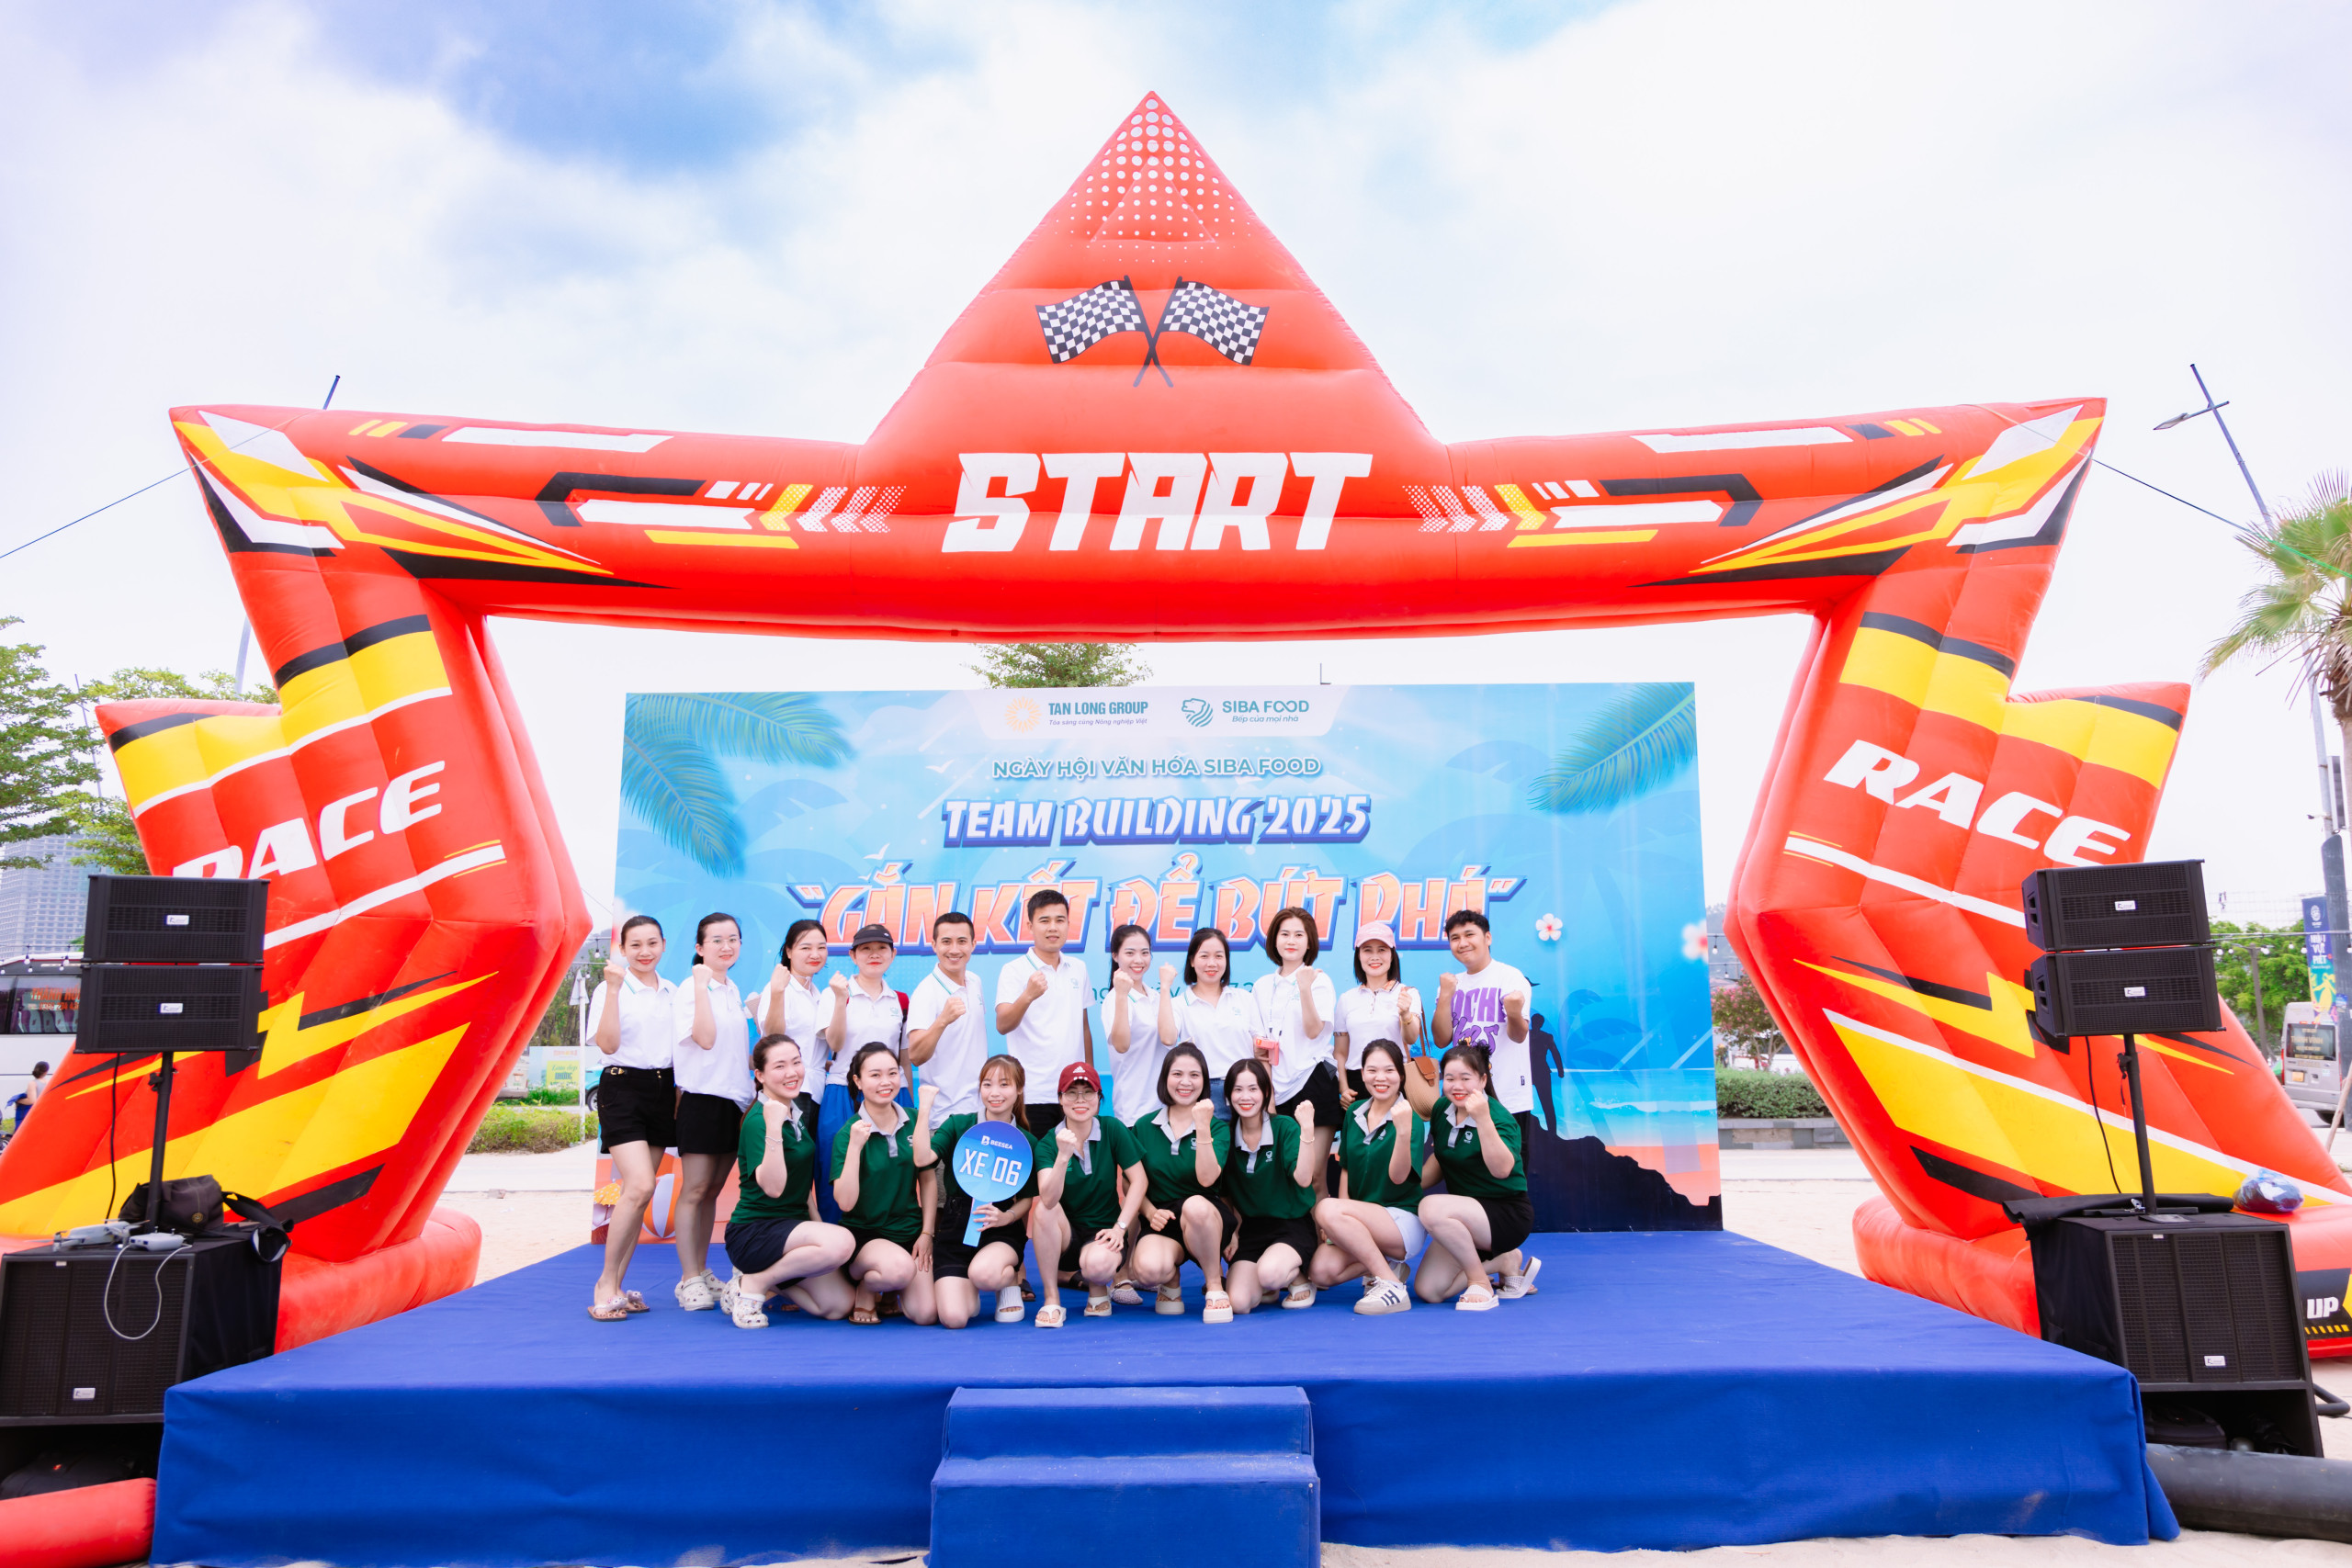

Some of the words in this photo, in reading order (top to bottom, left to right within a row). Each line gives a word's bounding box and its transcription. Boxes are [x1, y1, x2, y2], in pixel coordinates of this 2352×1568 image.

[941, 451, 1374, 553] START
[1048, 702, 1071, 716] TAN
[1074, 701, 1106, 716] LONG
[1108, 701, 1149, 715] GROUP
[1221, 700, 1260, 714] SIBA
[1263, 699, 1310, 714] FOOD
[992, 757, 1053, 778] NGÀY
[1057, 756, 1094, 781] HỘI
[1100, 755, 1146, 776] VĂN
[1150, 754, 1200, 775] HÓA
[1203, 757, 1254, 774] SIBA
[1257, 757, 1321, 774] FOOD
[1823, 739, 2131, 867] RACE
[944, 798, 1056, 842] TEAM
[1063, 795, 1253, 840] BUILDING
[1263, 795, 1368, 839] 2025
[990, 1139, 1013, 1150] BEESEA
[959, 1147, 989, 1179] XE
[990, 1156, 1023, 1187] 06
[2306, 1296, 2339, 1320] UP
